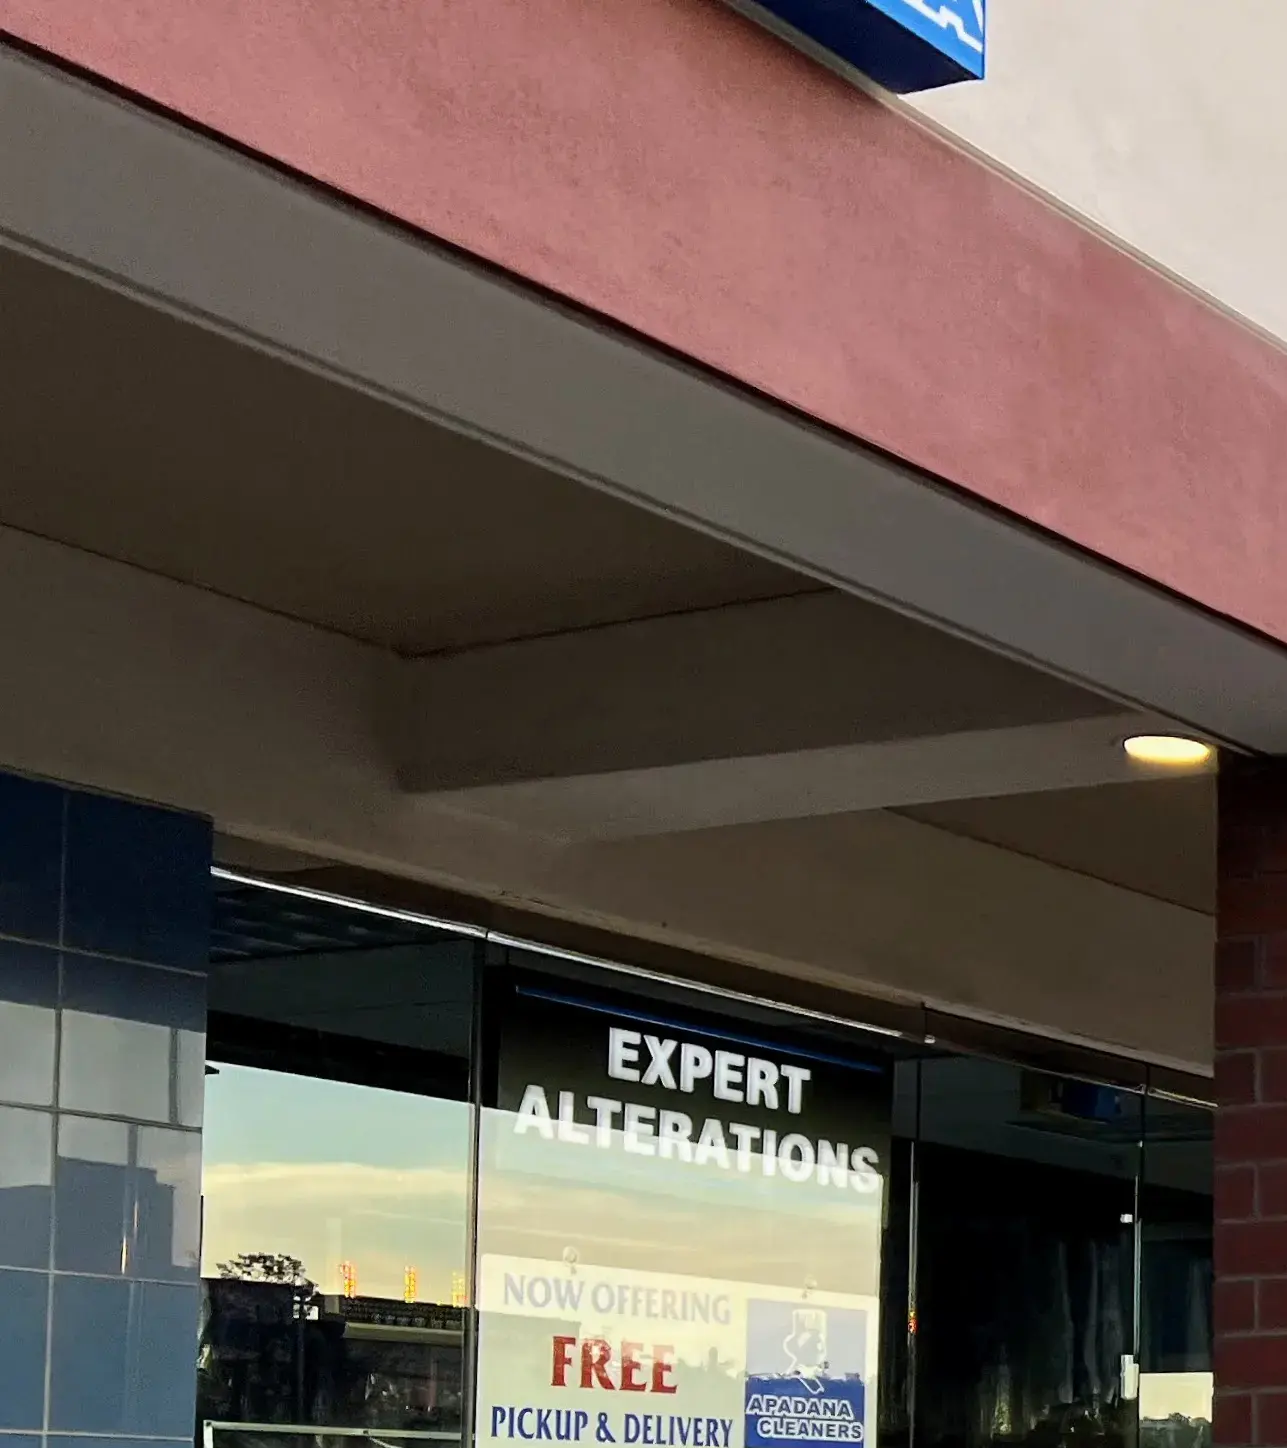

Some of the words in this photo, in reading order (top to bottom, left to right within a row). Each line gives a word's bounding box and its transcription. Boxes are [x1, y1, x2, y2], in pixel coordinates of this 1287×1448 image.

[608, 1027, 811, 1114] EXPERT
[514, 1085, 880, 1193] ALTERATIONS
[503, 1273, 584, 1311] NOW
[591, 1284, 731, 1325] OFFERING
[551, 1335, 678, 1394] FREE
[491, 1405, 588, 1441] PICKUP
[596, 1412, 616, 1443] &
[624, 1413, 733, 1448] DELIVERY
[745, 1394, 855, 1420] APADANA
[757, 1416, 863, 1442] CLEANERS
